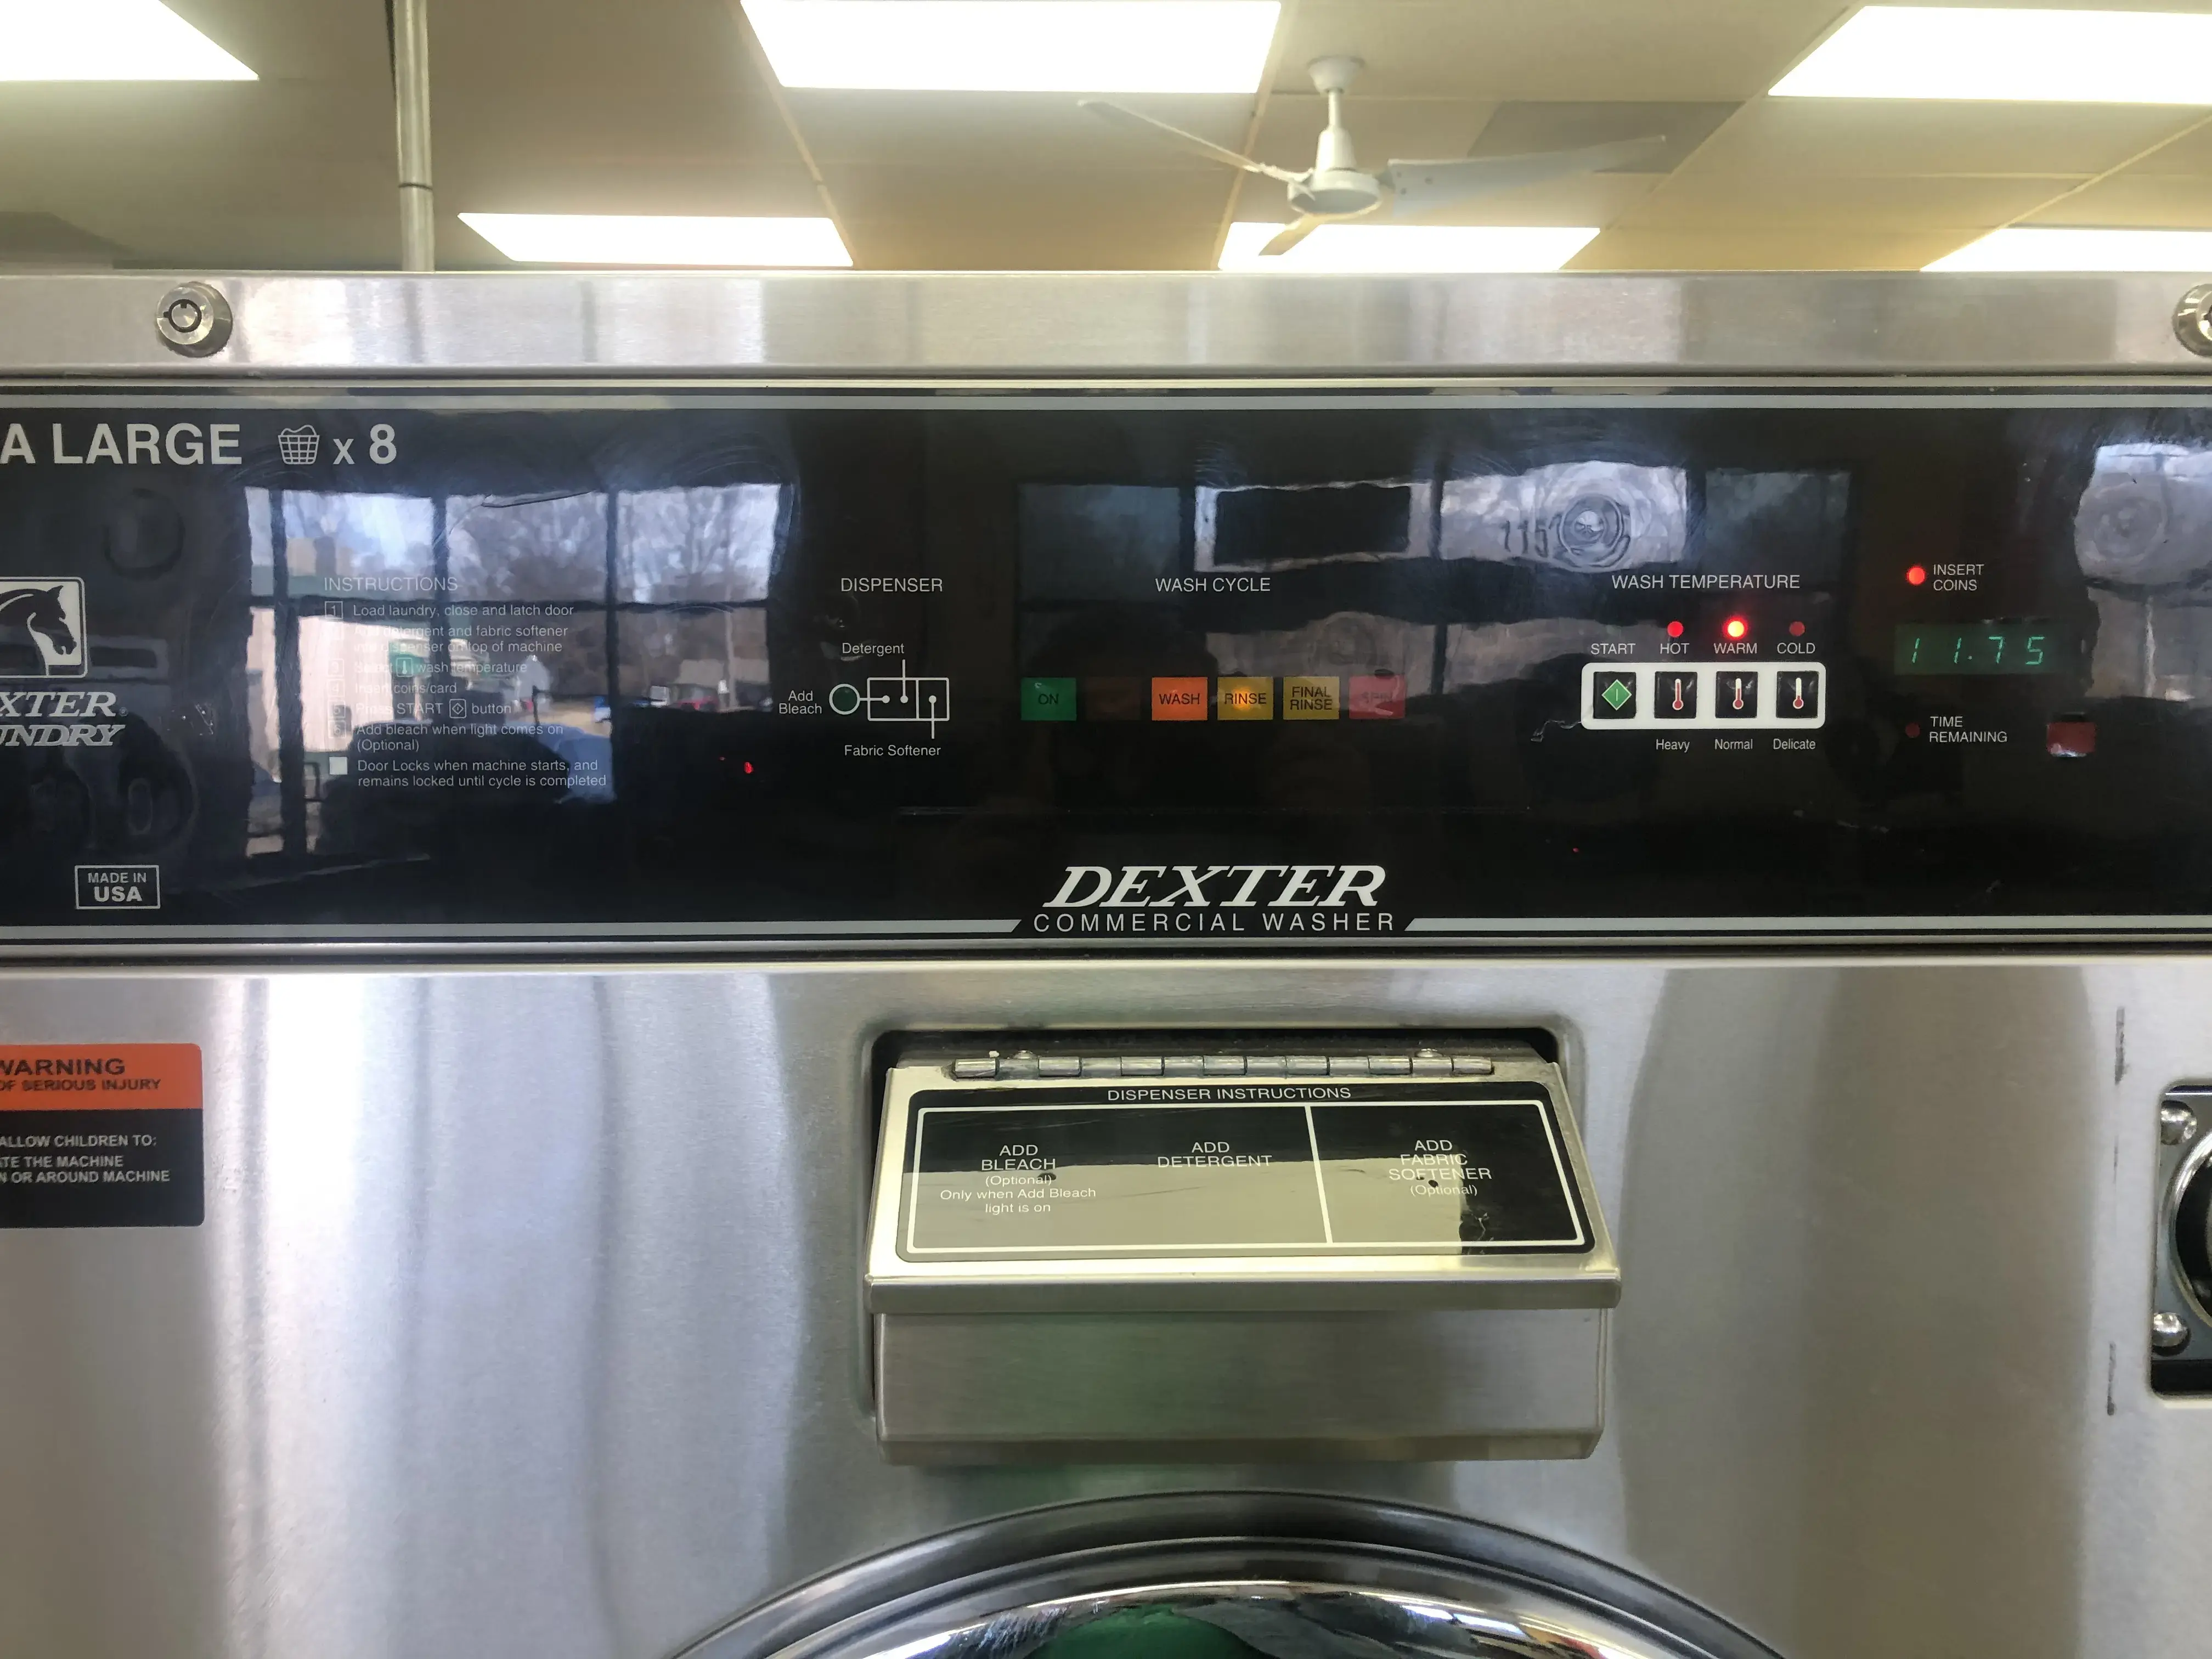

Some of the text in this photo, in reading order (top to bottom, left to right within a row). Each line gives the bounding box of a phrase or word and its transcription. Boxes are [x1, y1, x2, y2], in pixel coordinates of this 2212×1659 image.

[53, 423, 242, 465] LARGE
[333, 424, 397, 465] x 8
[1933, 564, 1984, 575] INSERT
[324, 577, 458, 591] INSTRUCTIONS
[841, 578, 943, 592] DISPENSER
[1155, 578, 1271, 592] WASH CYCLE
[1612, 574, 1800, 589] WASH TEMPERATURE
[1933, 579, 1977, 591] COINS
[353, 605, 385, 616] Load
[389, 605, 440, 618] laundry,
[444, 605, 478, 616] close
[482, 605, 506, 616] and
[510, 604, 540, 616] latch
[545, 604, 574, 616] door
[354, 626, 379, 636] Ad
[384, 626, 444, 640] detergent
[448, 625, 472, 636] and
[476, 625, 511, 636] fabric
[516, 625, 568, 636] softener
[467, 642, 488, 653] top
[492, 641, 504, 652] of
[508, 641, 562, 652] machine
[842, 642, 905, 657] Detergent
[1590, 643, 1636, 654] START
[1660, 642, 1690, 654] HOT
[1713, 642, 1758, 654] WARM
[1777, 642, 1815, 654] COLD
[417, 662, 448, 673] wash
[452, 662, 527, 674] temperature
[394, 682, 456, 693] coins/card
[1292, 686, 1331, 698] FINAL
[788, 690, 813, 702] Add
[1039, 693, 1059, 705] ON
[1159, 693, 1200, 705] WASH
[1224, 693, 1266, 704] RINSE
[397, 703, 443, 714] START
[472, 703, 511, 714] button
[778, 703, 822, 714] Bleach
[1290, 699, 1333, 710] RINSE
[1931, 716, 1963, 727] TIME
[357, 725, 381, 735] Add
[386, 724, 428, 735] bleach
[432, 725, 466, 735] when
[471, 723, 496, 737] light
[501, 726, 543, 735] comes
[548, 725, 563, 735] on
[1929, 731, 2007, 743] REMAINING
[357, 739, 419, 753] (Optional)
[844, 744, 941, 756] Fabric Softener
[1656, 738, 1690, 753] Heavy
[1714, 738, 1753, 750] Normal
[1773, 738, 1816, 750] Delicate
[358, 759, 597, 772] Door Locks when machine starts, and
[358, 775, 606, 789] remains locked until cycle is completed
[88, 872, 146, 883] MADE IN
[1042, 865, 1386, 907] DEXTER
[94, 886, 143, 902] USA
[1034, 913, 1393, 932] COMMERCIAL WASHER
[21, 1080, 96, 1091] SERIOUS
[102, 1079, 161, 1091] INJURY
[1108, 1087, 1352, 1101] DISPENSER INSTRUCTIONS
[0, 1135, 51, 1148] ALLOW
[54, 1135, 128, 1147] CHILDREN
[1192, 1141, 1230, 1154] ADD
[1414, 1139, 1452, 1152] ADD
[999, 1144, 1039, 1156] ADD
[24, 1156, 53, 1168] THE
[57, 1155, 123, 1167] MACHINE
[981, 1158, 1056, 1171] BLEACH
[1158, 1155, 1272, 1168] DETERGENT
[1400, 1154, 1468, 1166] FABRIC
[12, 1171, 33, 1183] OR
[35, 1170, 99, 1183] AROUND
[103, 1170, 170, 1183] MACHINE
[1388, 1167, 1492, 1181] SOFTENER
[985, 1175, 1052, 1188] (Optional)
[940, 1187, 1096, 1201] Only when Add Bleach
[1410, 1184, 1477, 1197] (Optional)
[985, 1203, 1051, 1216] light is on
